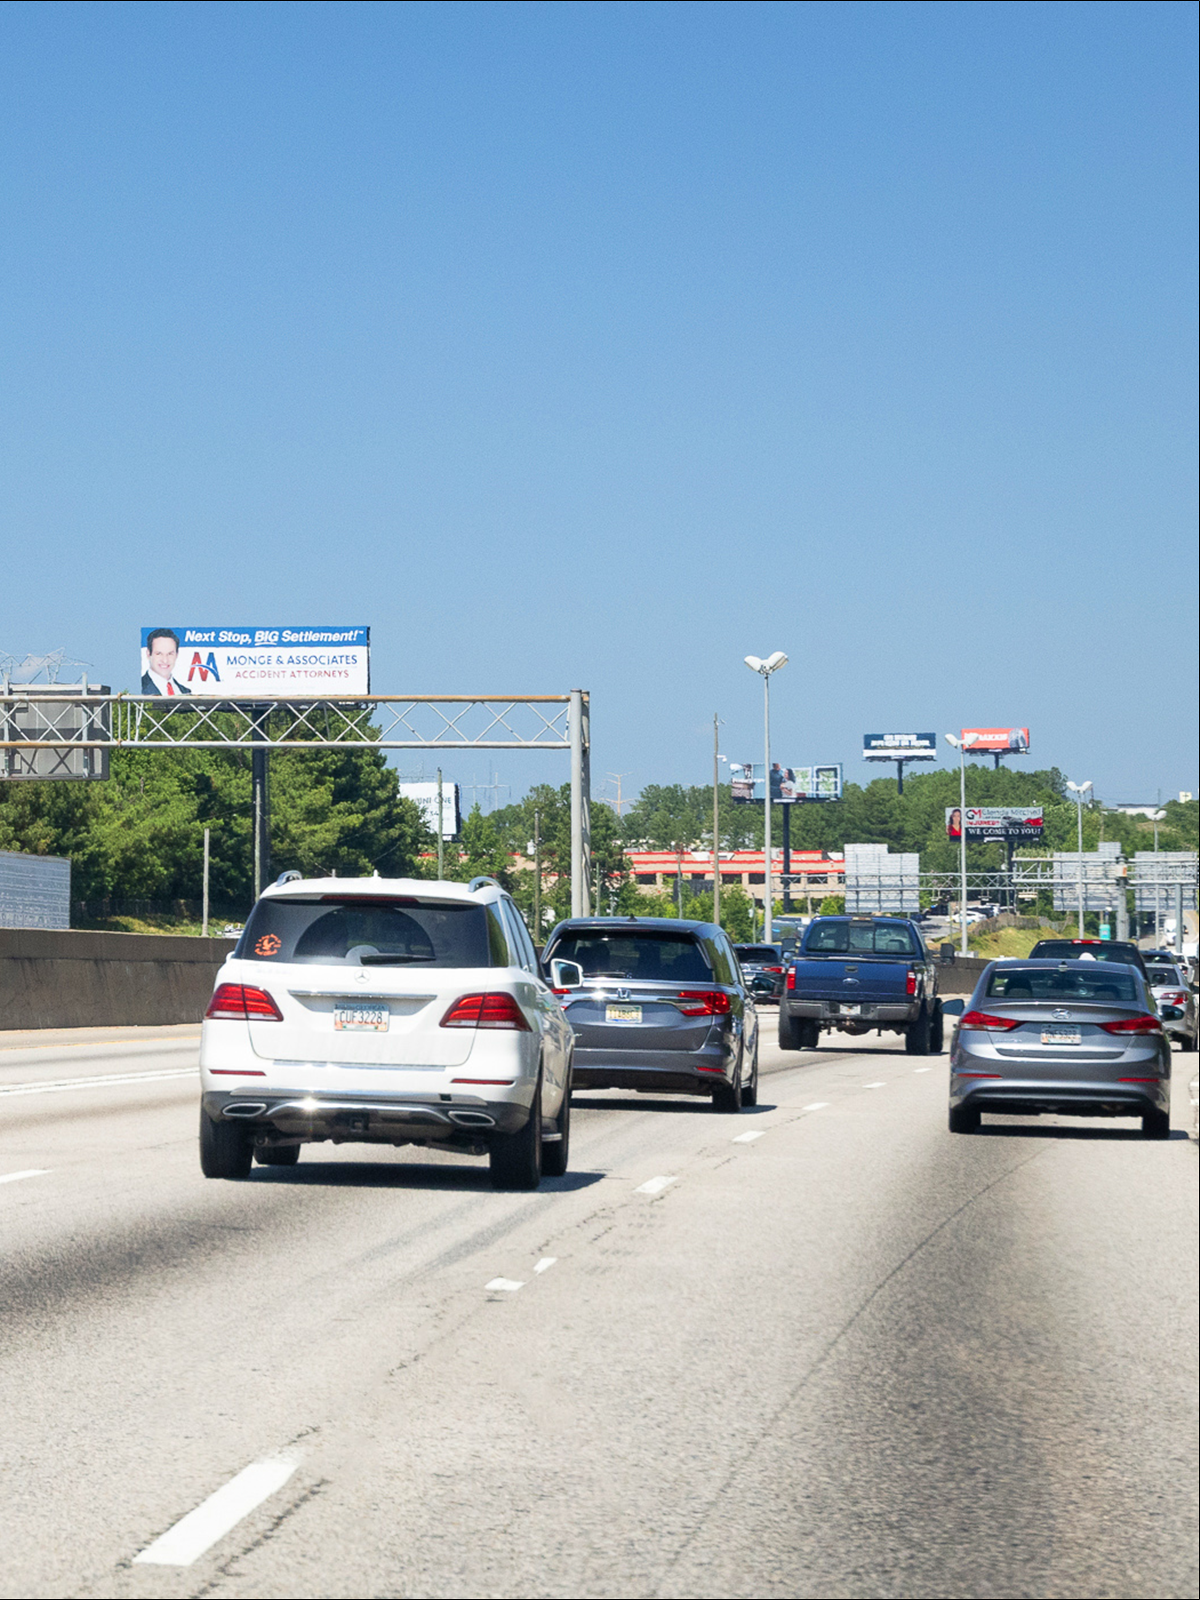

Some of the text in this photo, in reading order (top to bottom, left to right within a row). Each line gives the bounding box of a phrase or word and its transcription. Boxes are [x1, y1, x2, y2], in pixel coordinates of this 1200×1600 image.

[185, 630, 216, 642] Next
[218, 630, 252, 645] Stop,
[254, 630, 280, 642] BIG
[227, 654, 358, 665] MONGE & ASSOCIATES
[235, 669, 350, 679] ACCIDENT ATTORNEYS
[339, 1011, 383, 1025] CUF3228
